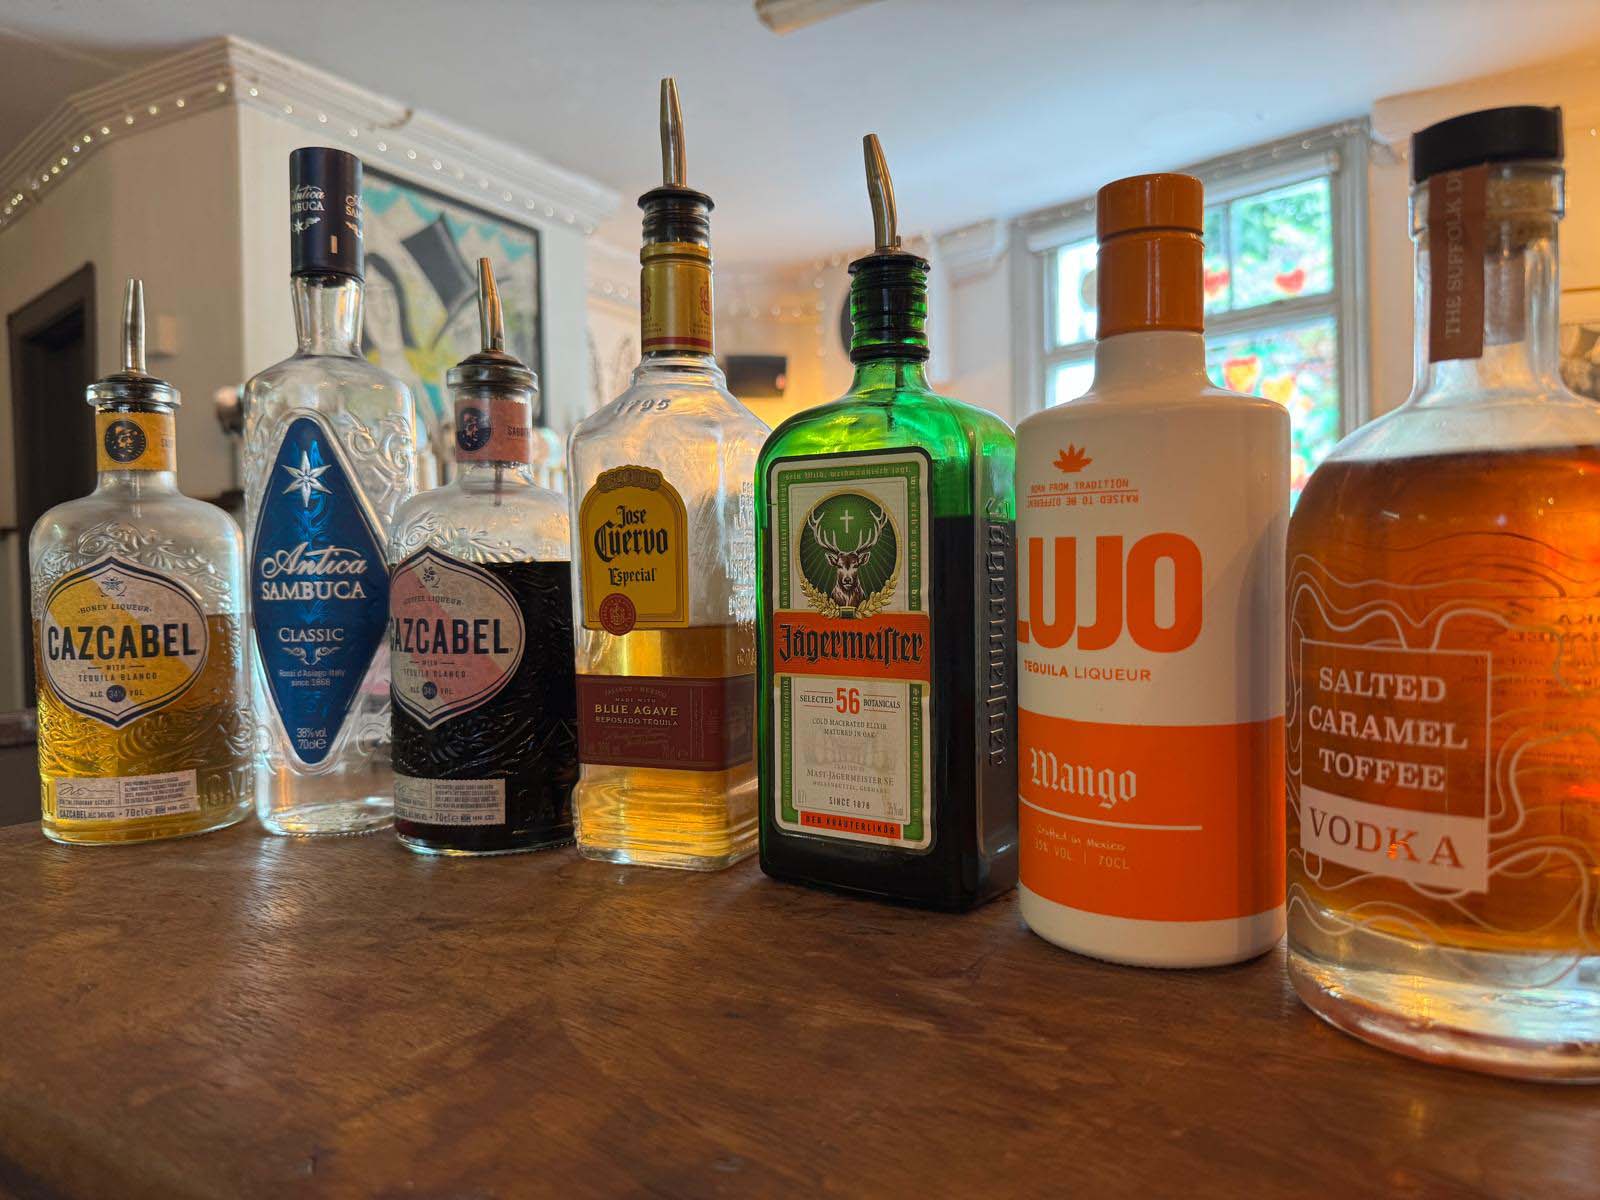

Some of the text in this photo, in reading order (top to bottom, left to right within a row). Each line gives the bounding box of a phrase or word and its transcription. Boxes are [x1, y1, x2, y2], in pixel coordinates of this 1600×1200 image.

[1445, 197, 1464, 291] SUFFOLK
[1444, 295, 1461, 338] THE
[614, 398, 671, 416] 1795
[1048, 482, 1069, 491] FROM
[1072, 478, 1129, 490] TRADITION
[1067, 497, 1077, 506] BE
[1082, 495, 1093, 505] TO
[1100, 494, 1139, 505] RAISED
[615, 504, 647, 528] Jose
[594, 520, 668, 563] Cuervo
[261, 541, 368, 579] Antica
[608, 567, 655, 587] Especial
[261, 580, 367, 601] SAMBUCA
[428, 595, 462, 606] LIQUEUR
[79, 603, 149, 614] HONEY LIQUEUR
[48, 623, 197, 661] CAZCABEL
[279, 627, 345, 643] CLASSIC
[78, 672, 157, 682] TEQUILA BLANCO
[1023, 659, 1152, 682] TEQUILA LIQUEUR
[291, 678, 310, 687] since
[1318, 666, 1447, 704] SALTED
[594, 704, 678, 716] BLUE AGAVE
[799, 687, 901, 715] SELECTED 56 BOTANICALS
[595, 716, 679, 726] REPOSADO TEQUILA
[812, 717, 887, 730] COLD MACERATED ELIXIR
[1307, 704, 1470, 750] CARAMEL
[823, 728, 853, 737] MATURED
[1029, 747, 1137, 810] Mango
[1318, 748, 1447, 793] TOFFEE
[829, 796, 850, 807] SINCE
[805, 814, 822, 825] DER
[1036, 824, 1127, 852] Crafted in Mexico
[1307, 806, 1466, 870] VODKA
[1054, 846, 1073, 861] VOL
[1097, 855, 1129, 870] 70CL
